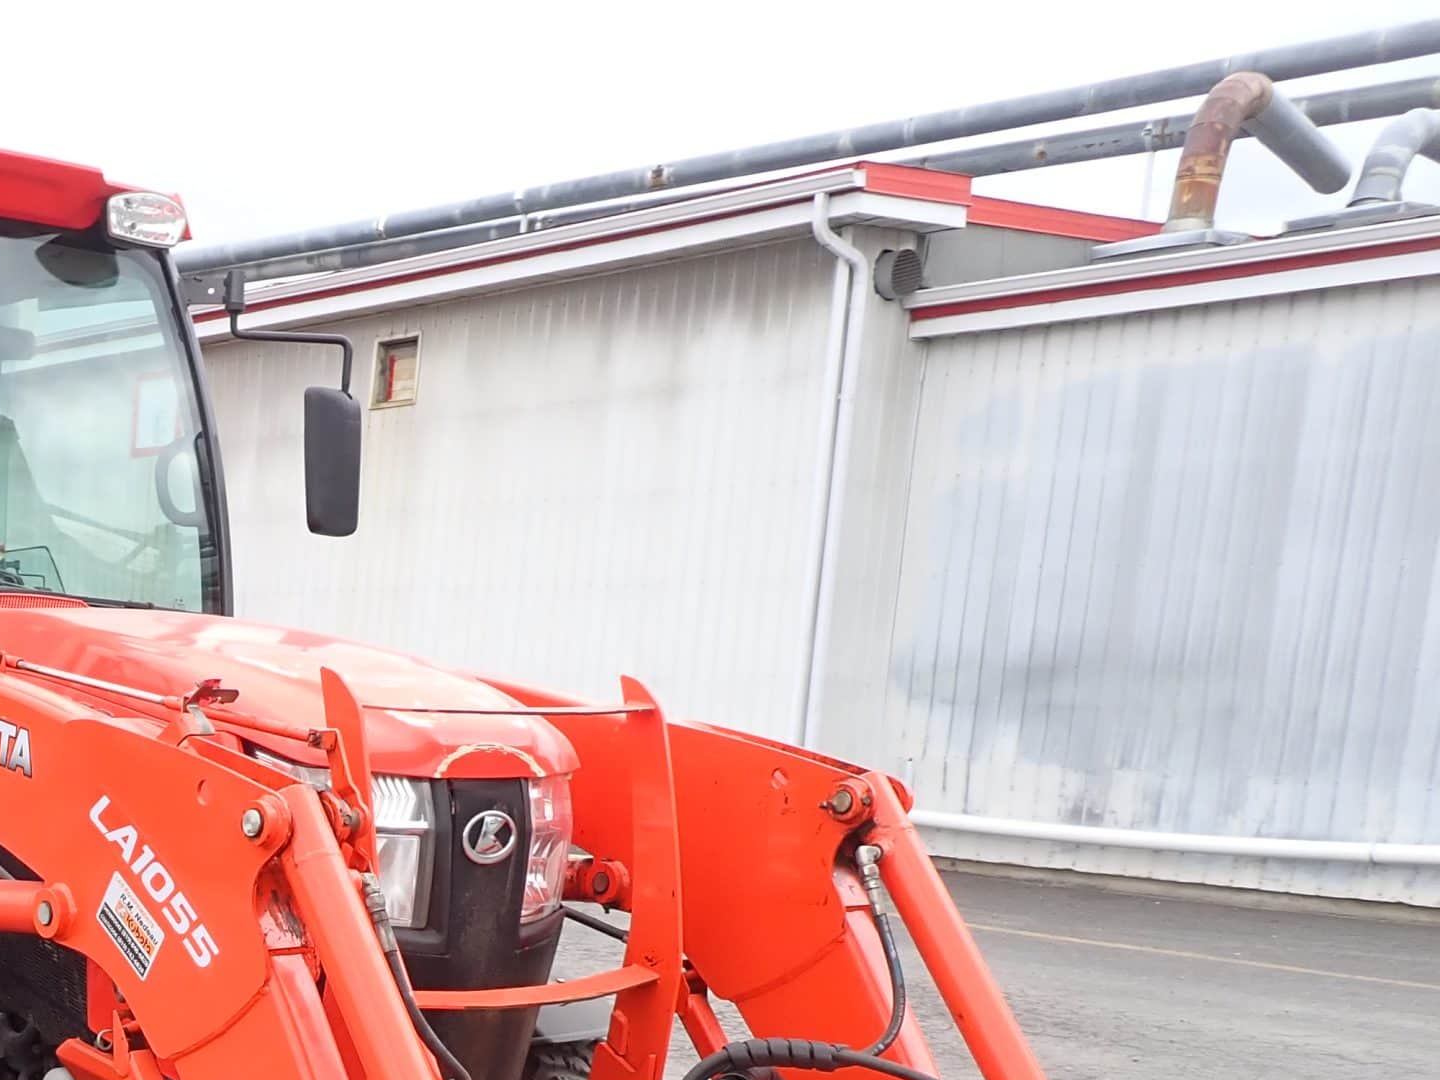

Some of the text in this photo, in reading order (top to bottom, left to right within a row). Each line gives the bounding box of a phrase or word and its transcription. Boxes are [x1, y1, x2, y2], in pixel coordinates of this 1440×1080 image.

[89, 795, 220, 968] LA1055
[125, 914, 153, 955] Kubota
[135, 912, 160, 946] Nadeau
